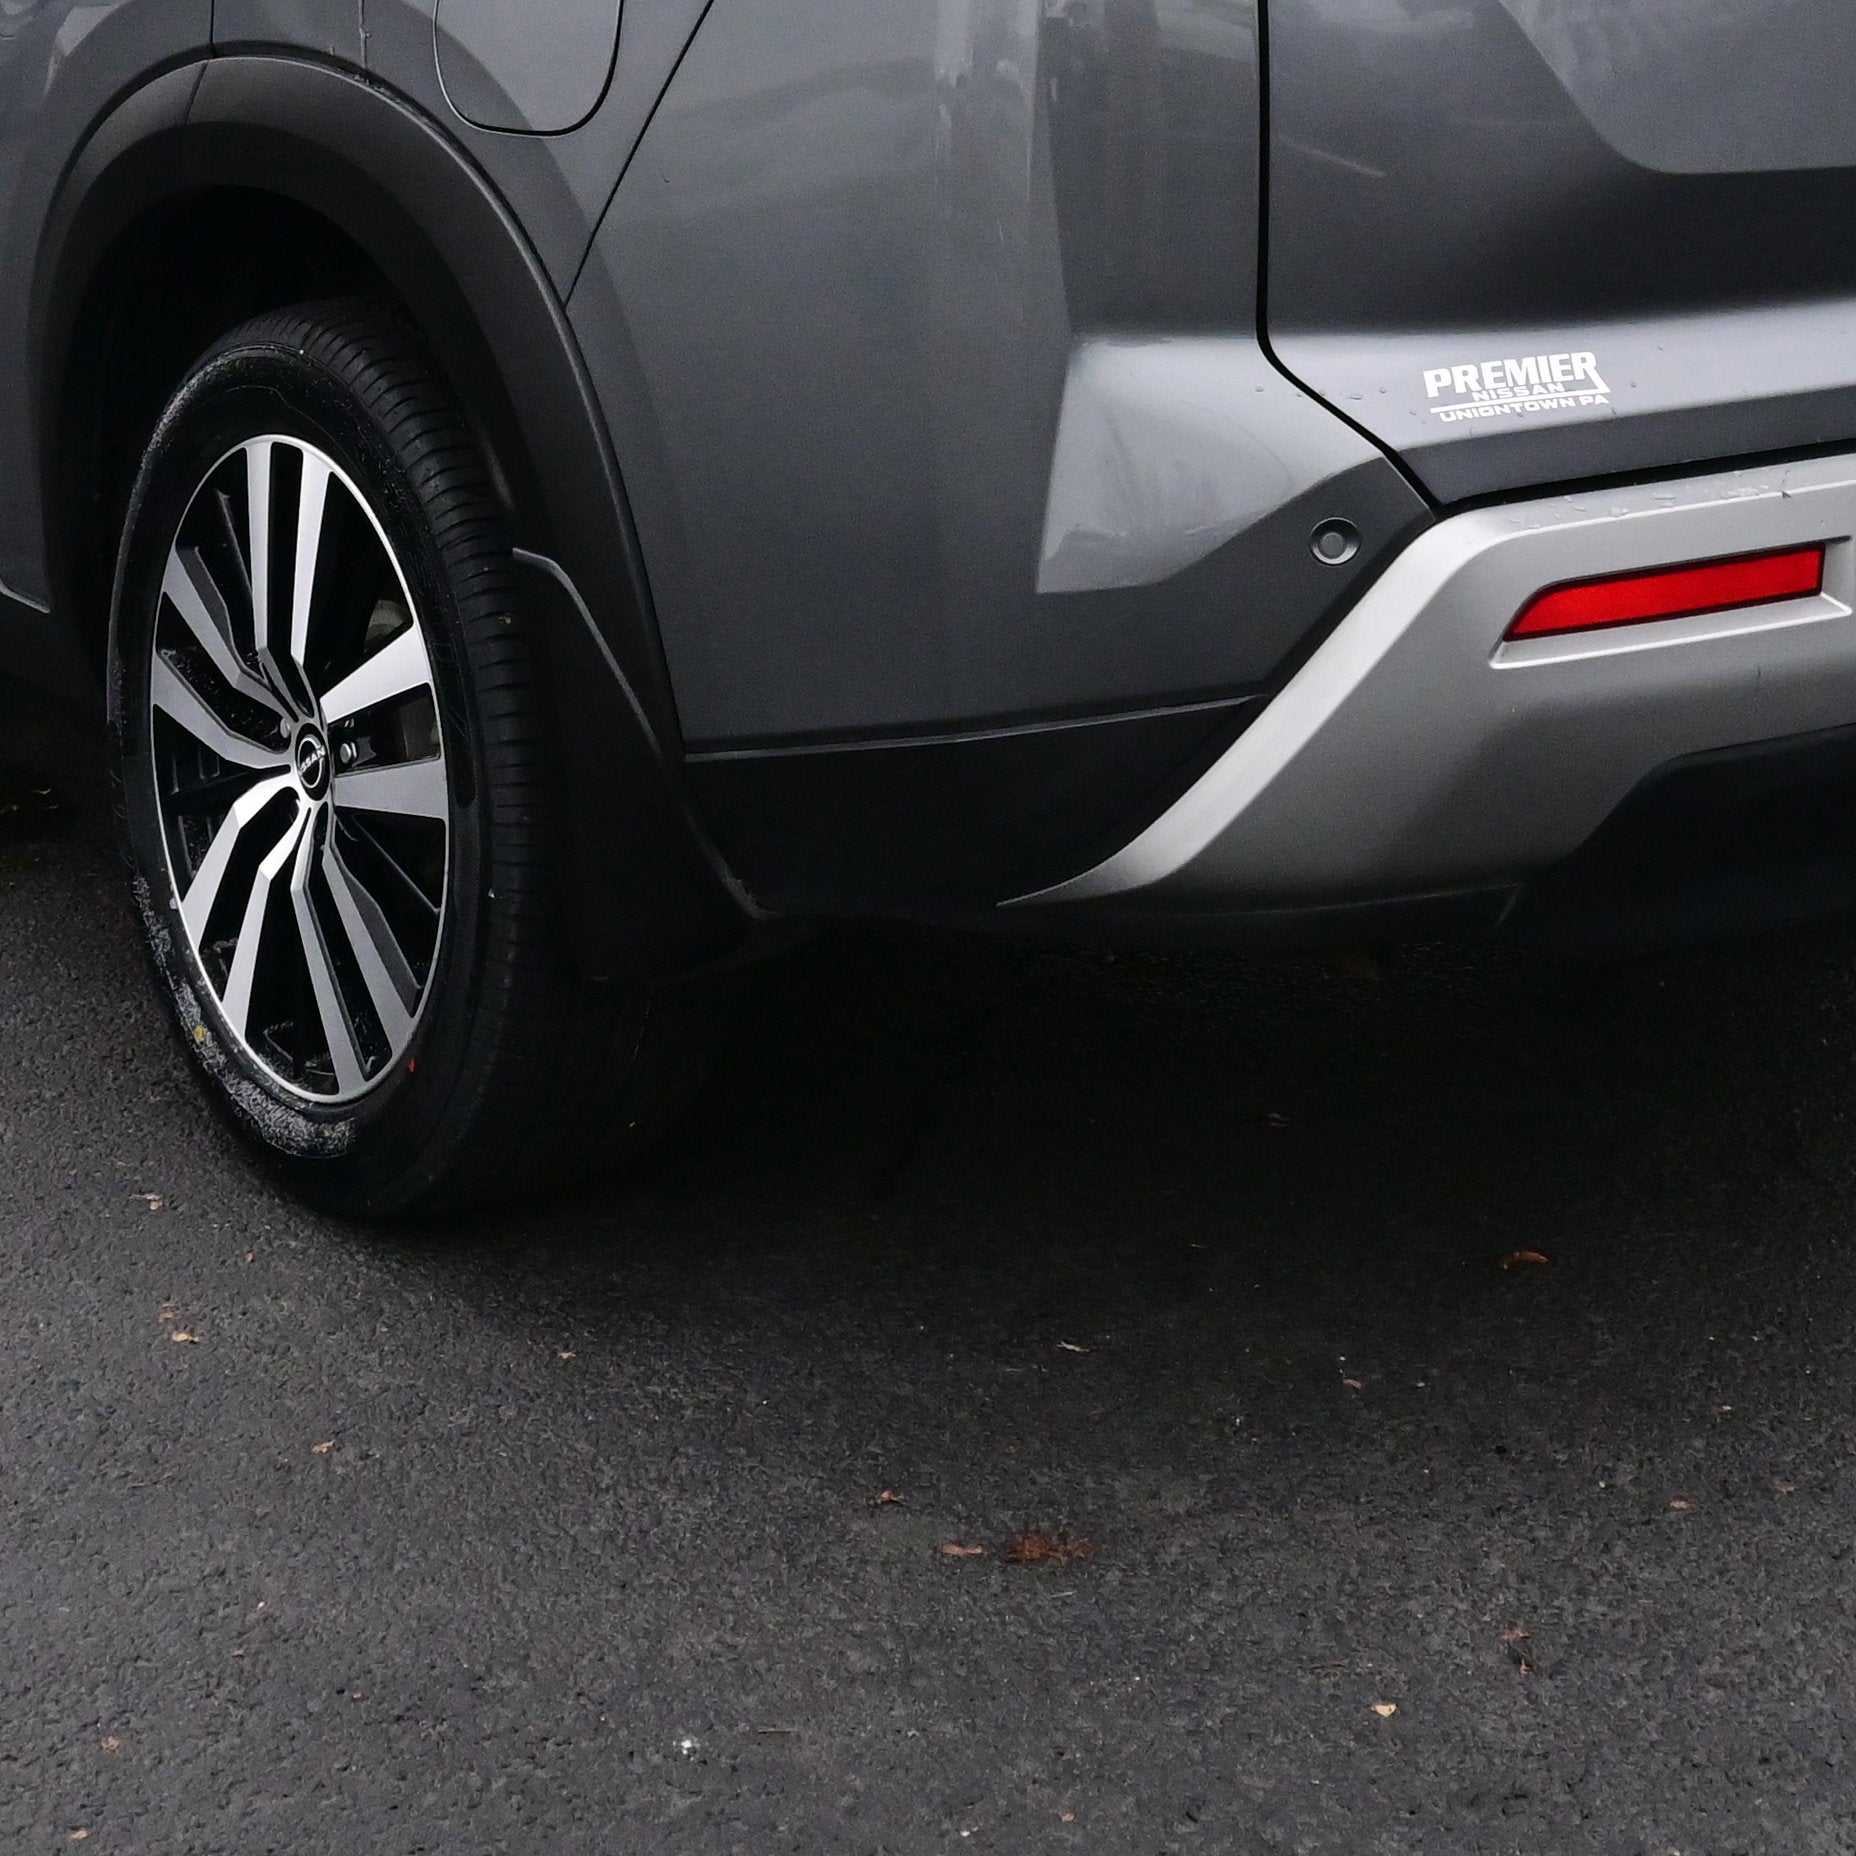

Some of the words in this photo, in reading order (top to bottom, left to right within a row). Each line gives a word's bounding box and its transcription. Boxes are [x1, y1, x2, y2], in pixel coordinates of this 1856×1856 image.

[1423, 351, 1611, 398] PREMIER
[1471, 382, 1565, 402] NISSAN
[1439, 395, 1576, 422] UNIONTOWN
[1579, 394, 1610, 406] PA
[297, 745, 326, 776] SSAN
